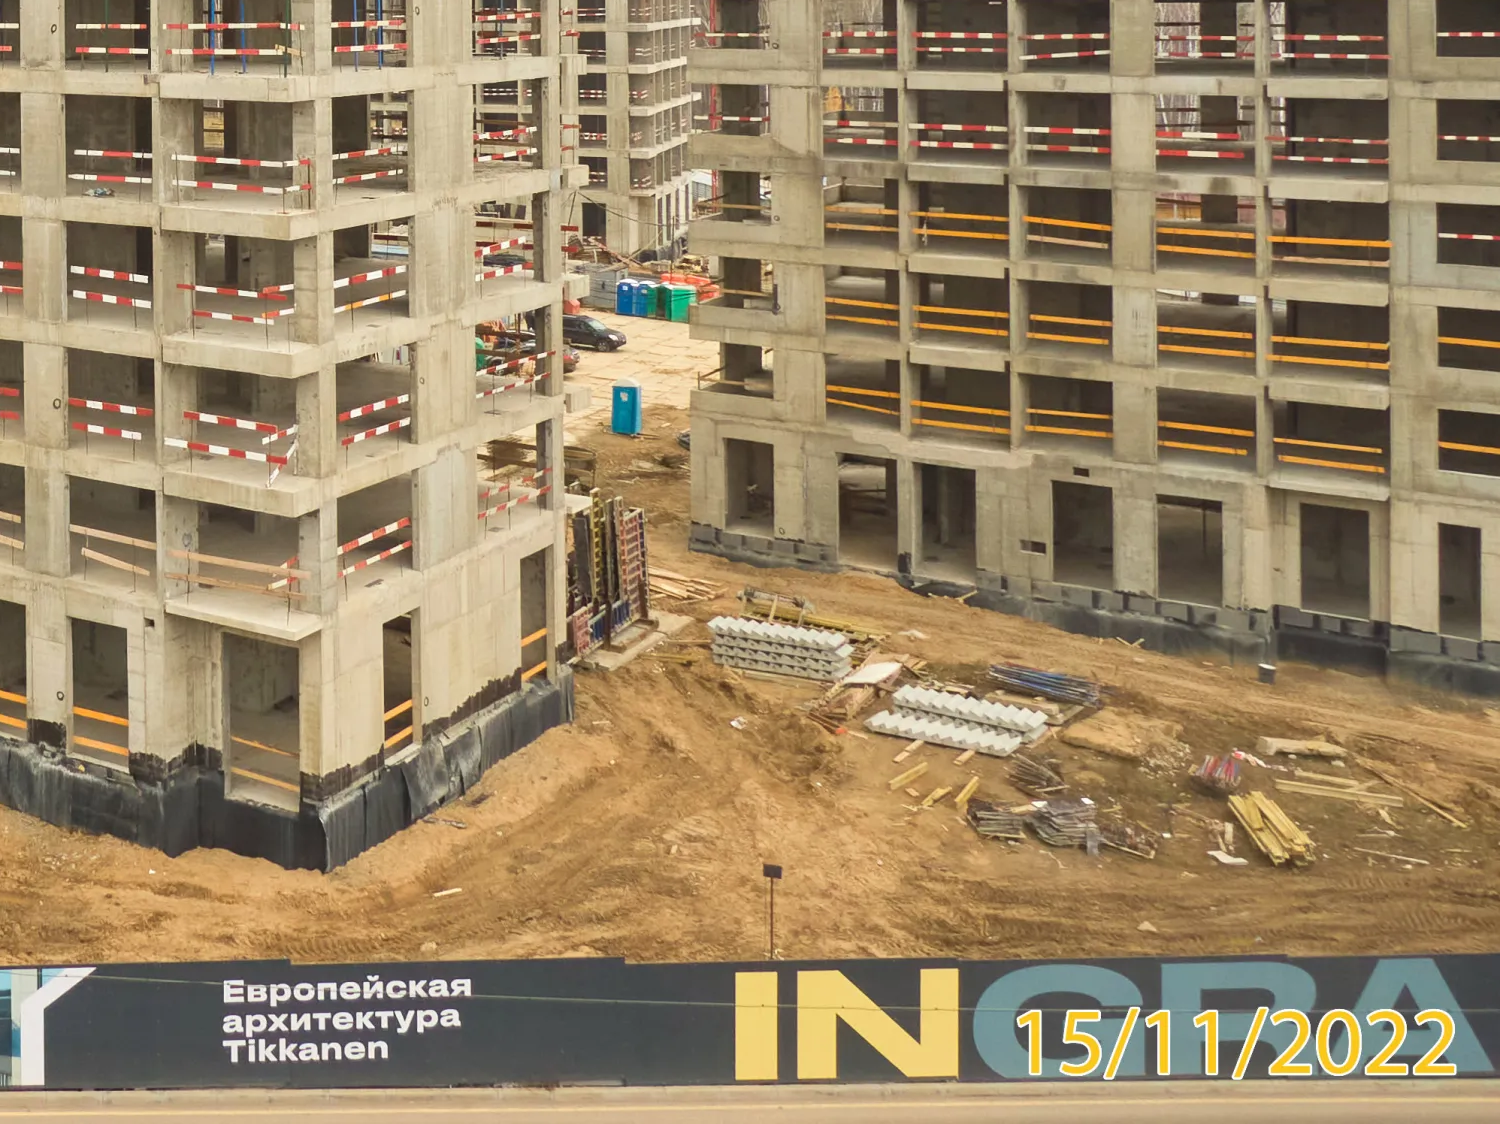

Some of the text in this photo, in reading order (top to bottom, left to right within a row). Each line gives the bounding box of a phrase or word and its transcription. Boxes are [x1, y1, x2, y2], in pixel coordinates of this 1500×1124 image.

[222, 974, 472, 1007] Европейская
[222, 1007, 462, 1037] архитектура
[222, 1037, 390, 1063] Tikkanen
